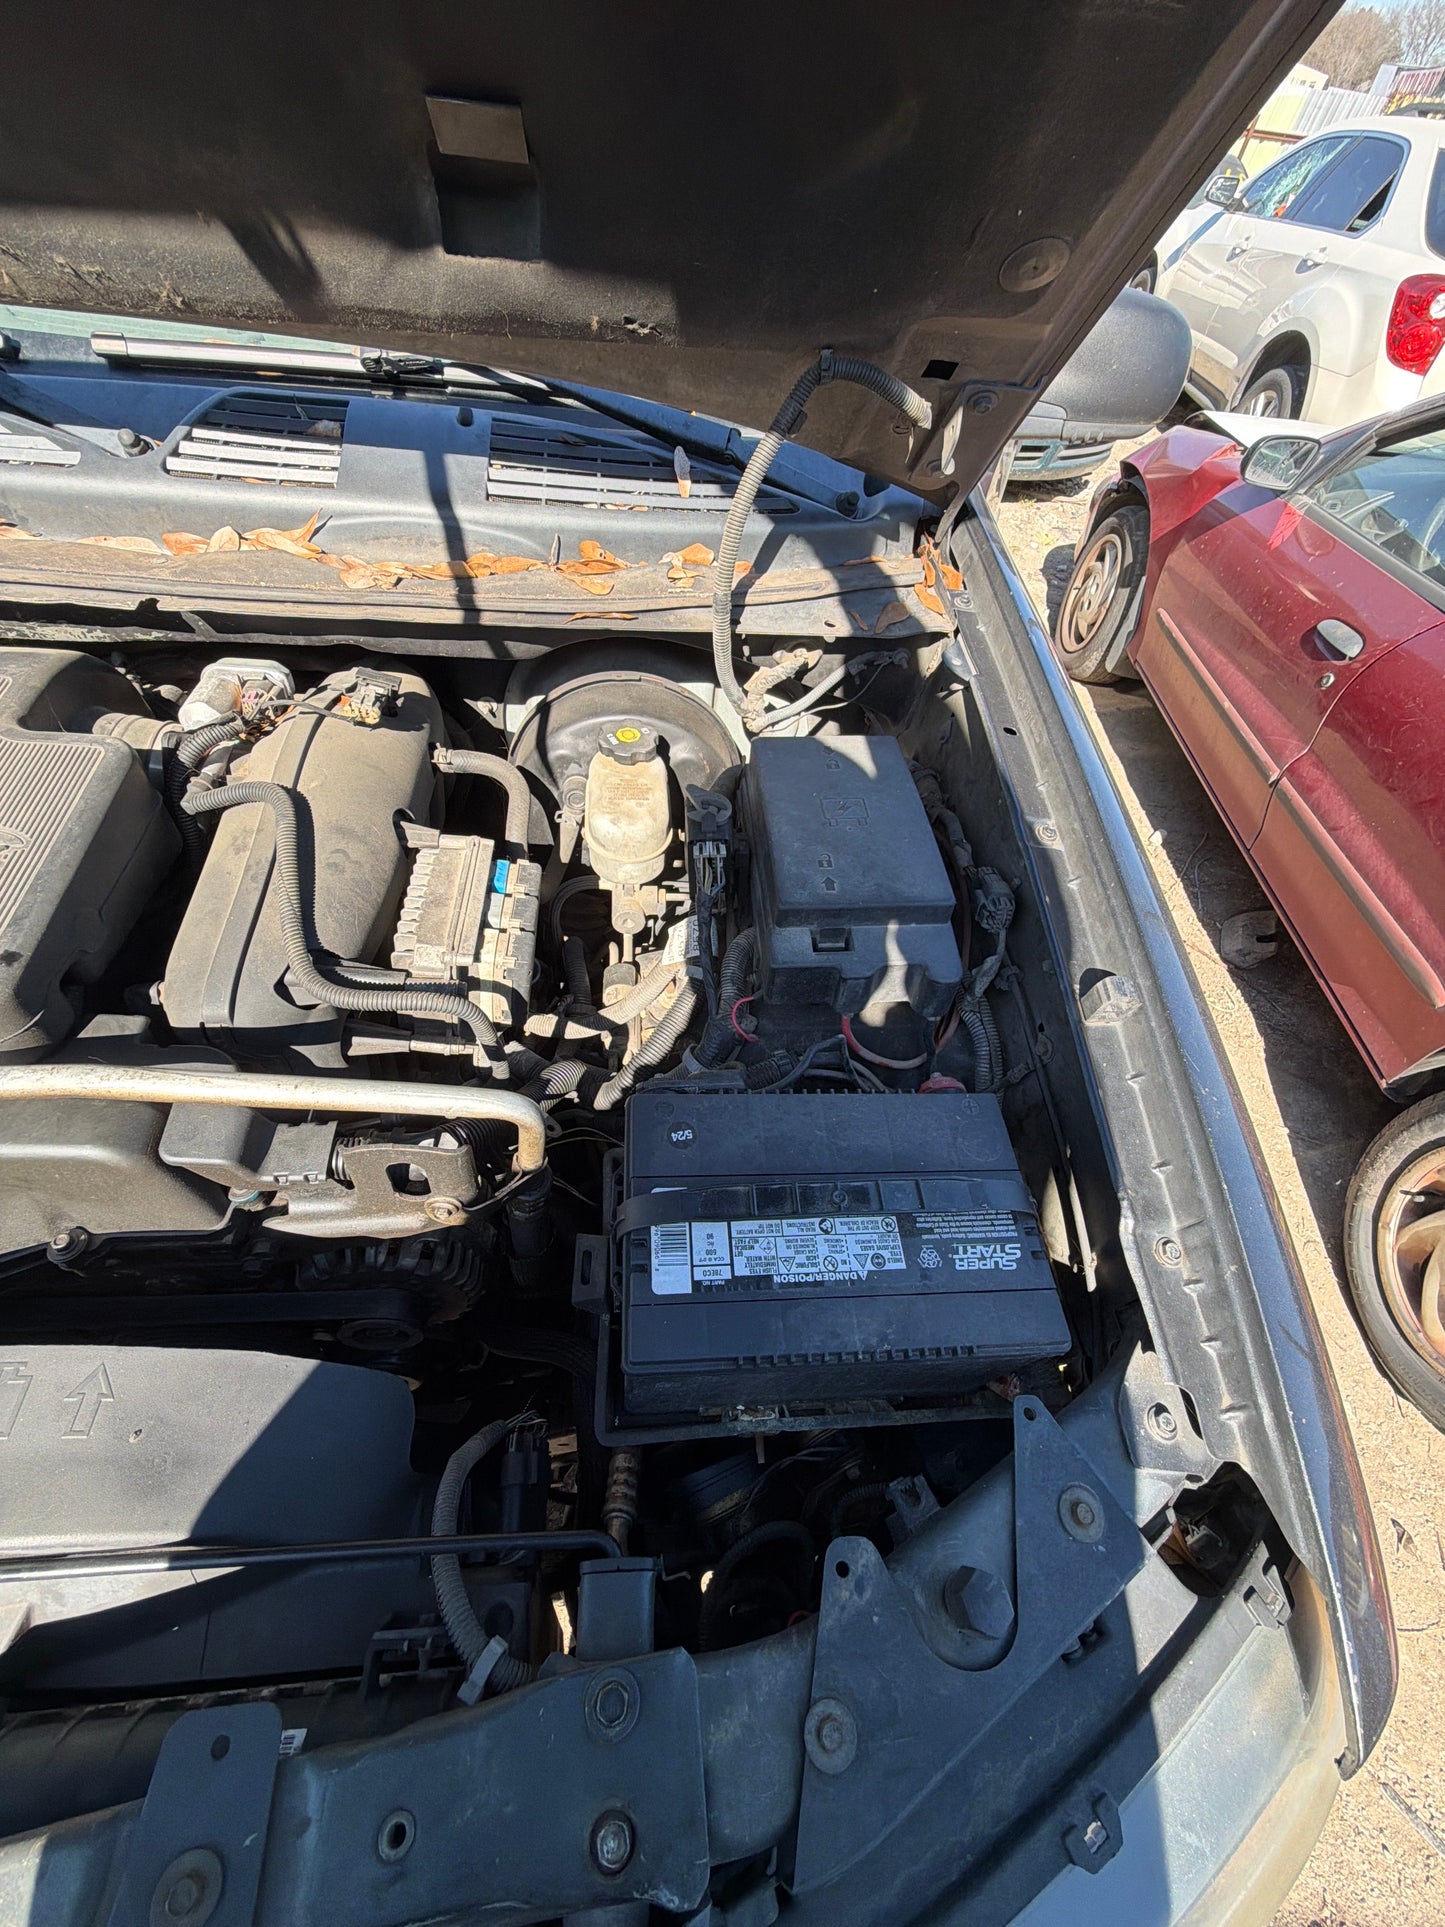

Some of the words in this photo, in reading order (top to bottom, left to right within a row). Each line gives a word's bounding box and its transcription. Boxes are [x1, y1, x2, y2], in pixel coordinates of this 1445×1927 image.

[671, 1129, 693, 1142] 5/24
[953, 1243, 1021, 1259] START
[955, 1258, 1017, 1270] SUPER
[773, 1271, 857, 1283] DANGER/POISON
